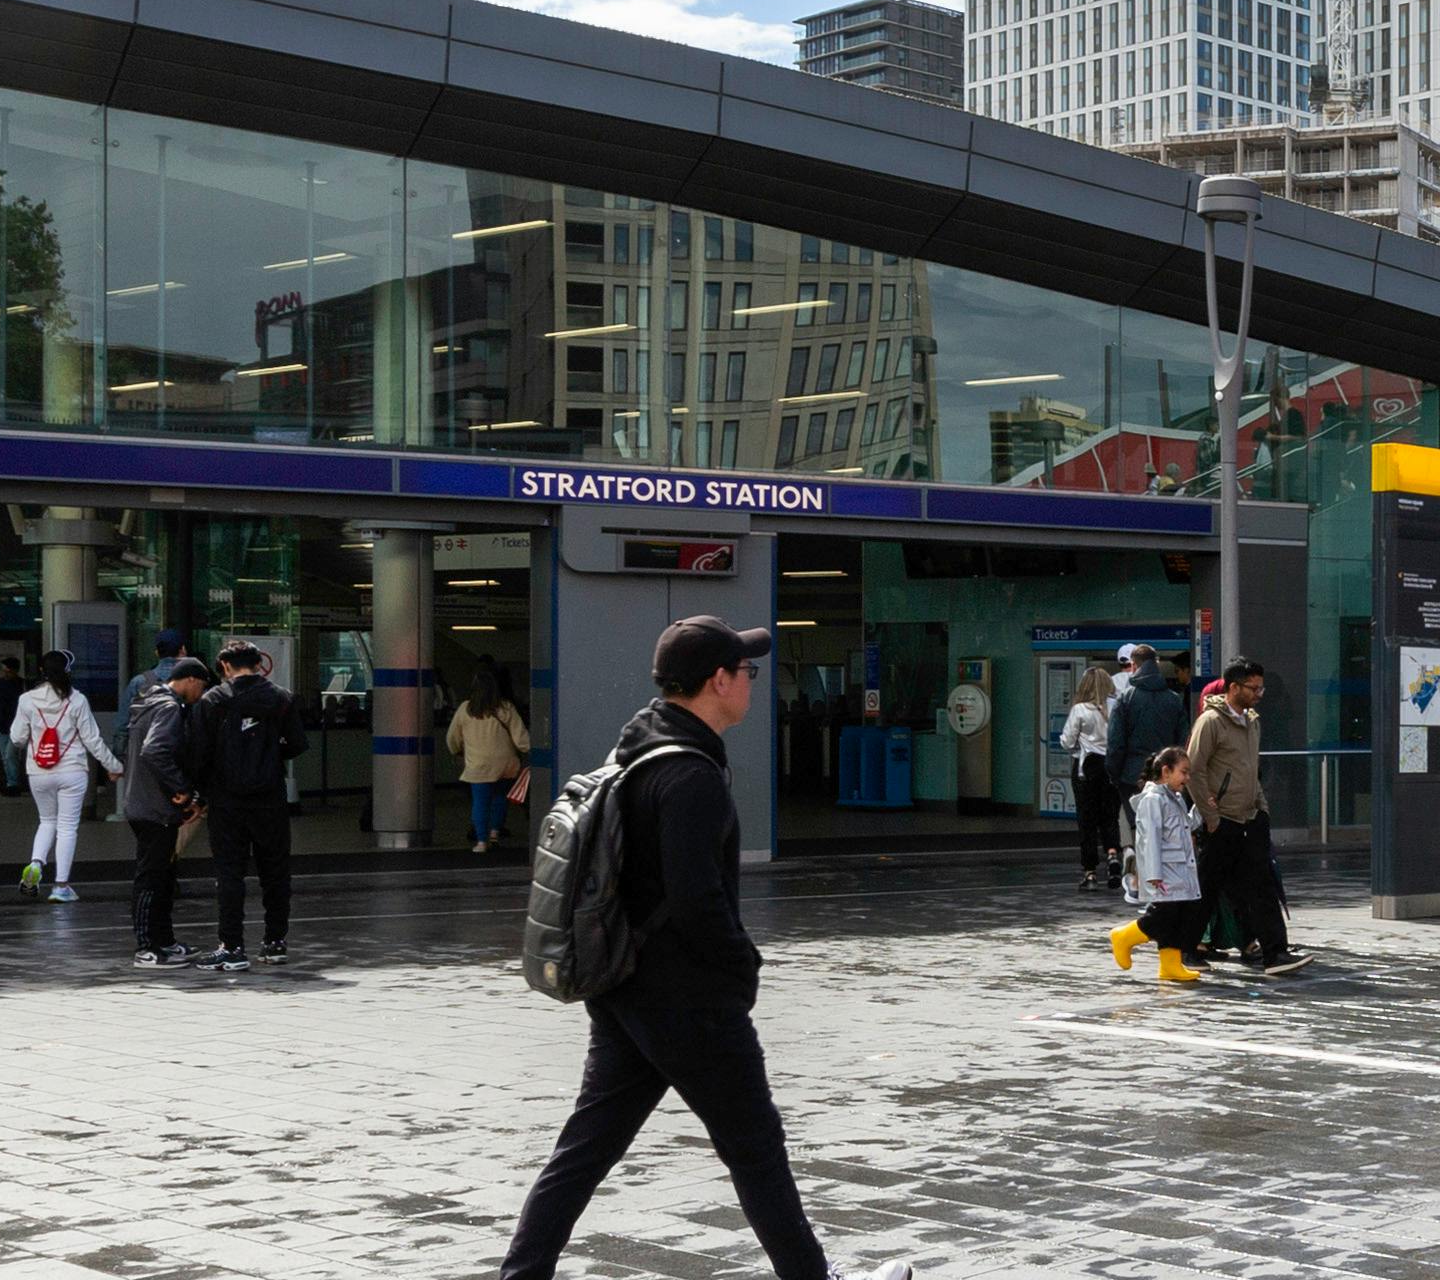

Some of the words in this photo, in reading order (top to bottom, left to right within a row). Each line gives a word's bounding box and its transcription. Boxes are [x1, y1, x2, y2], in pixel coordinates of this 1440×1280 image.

[521, 471, 697, 504] STRATFORD
[706, 480, 824, 510] STATION
[501, 535, 530, 549] Tickets
[1035, 627, 1070, 640] Tickets
